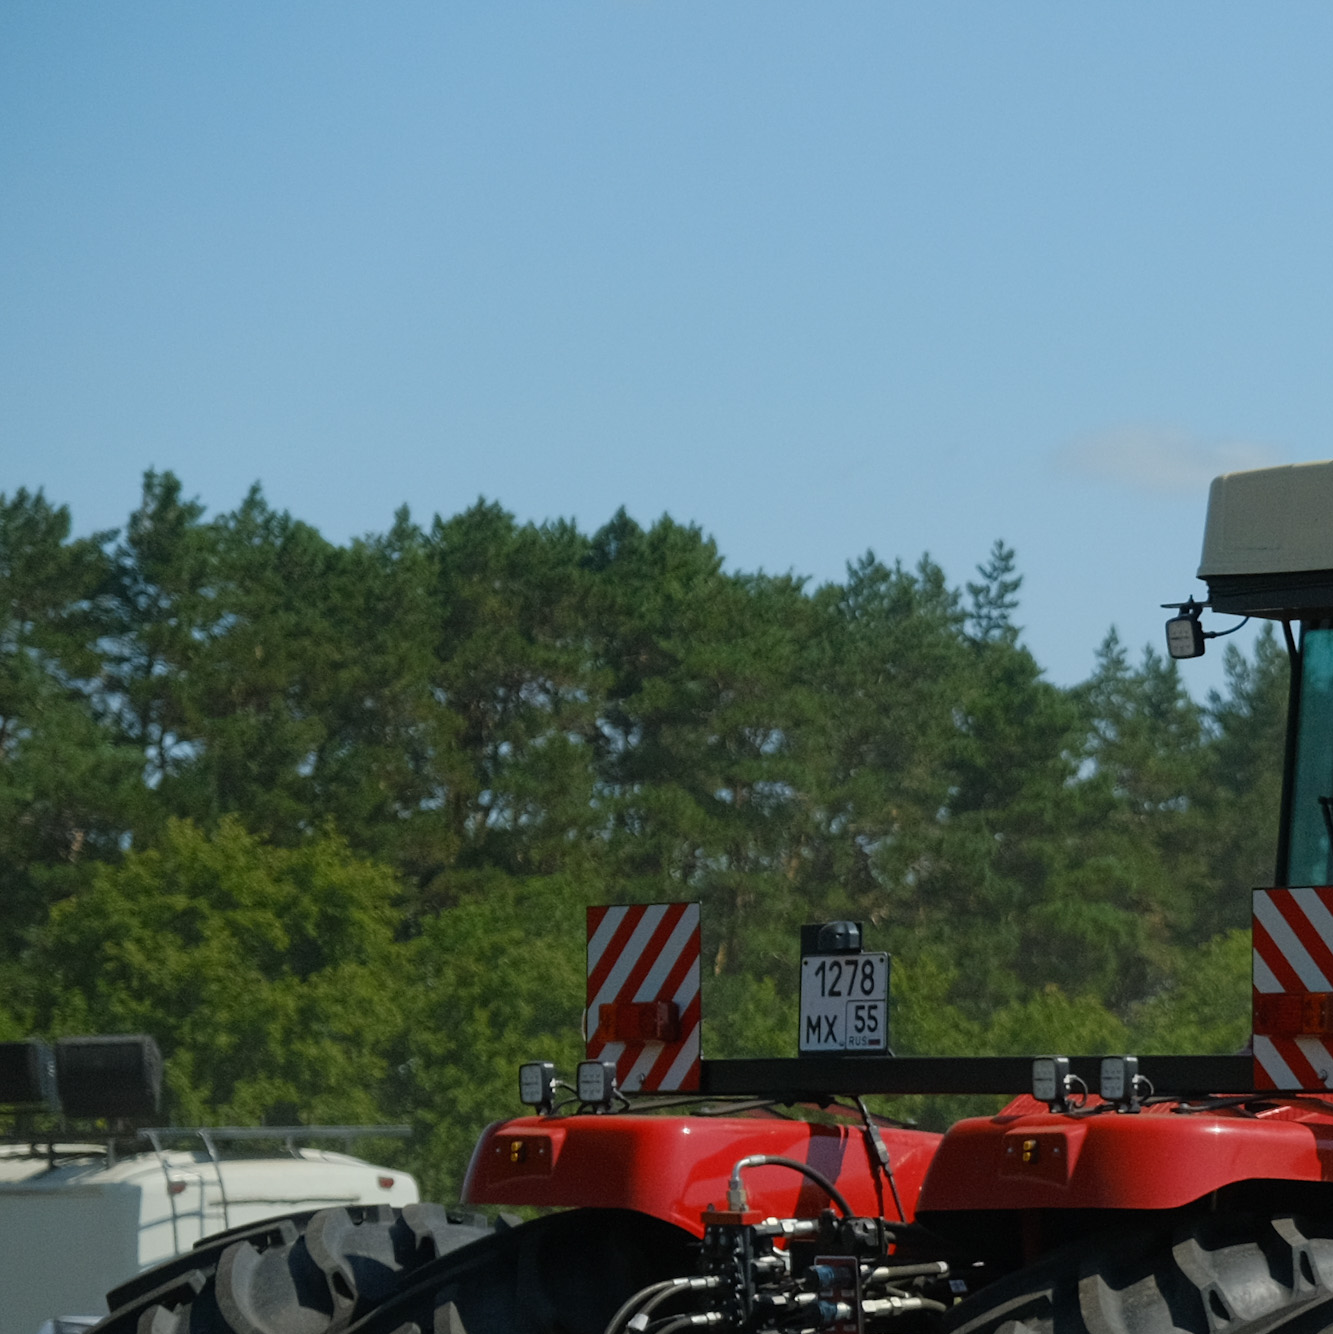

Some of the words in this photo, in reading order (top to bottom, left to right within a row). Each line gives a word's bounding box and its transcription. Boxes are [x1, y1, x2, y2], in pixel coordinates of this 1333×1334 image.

[814, 958, 875, 997] 1278
[854, 1005, 878, 1034] 55
[848, 1036, 868, 1046] RUS
